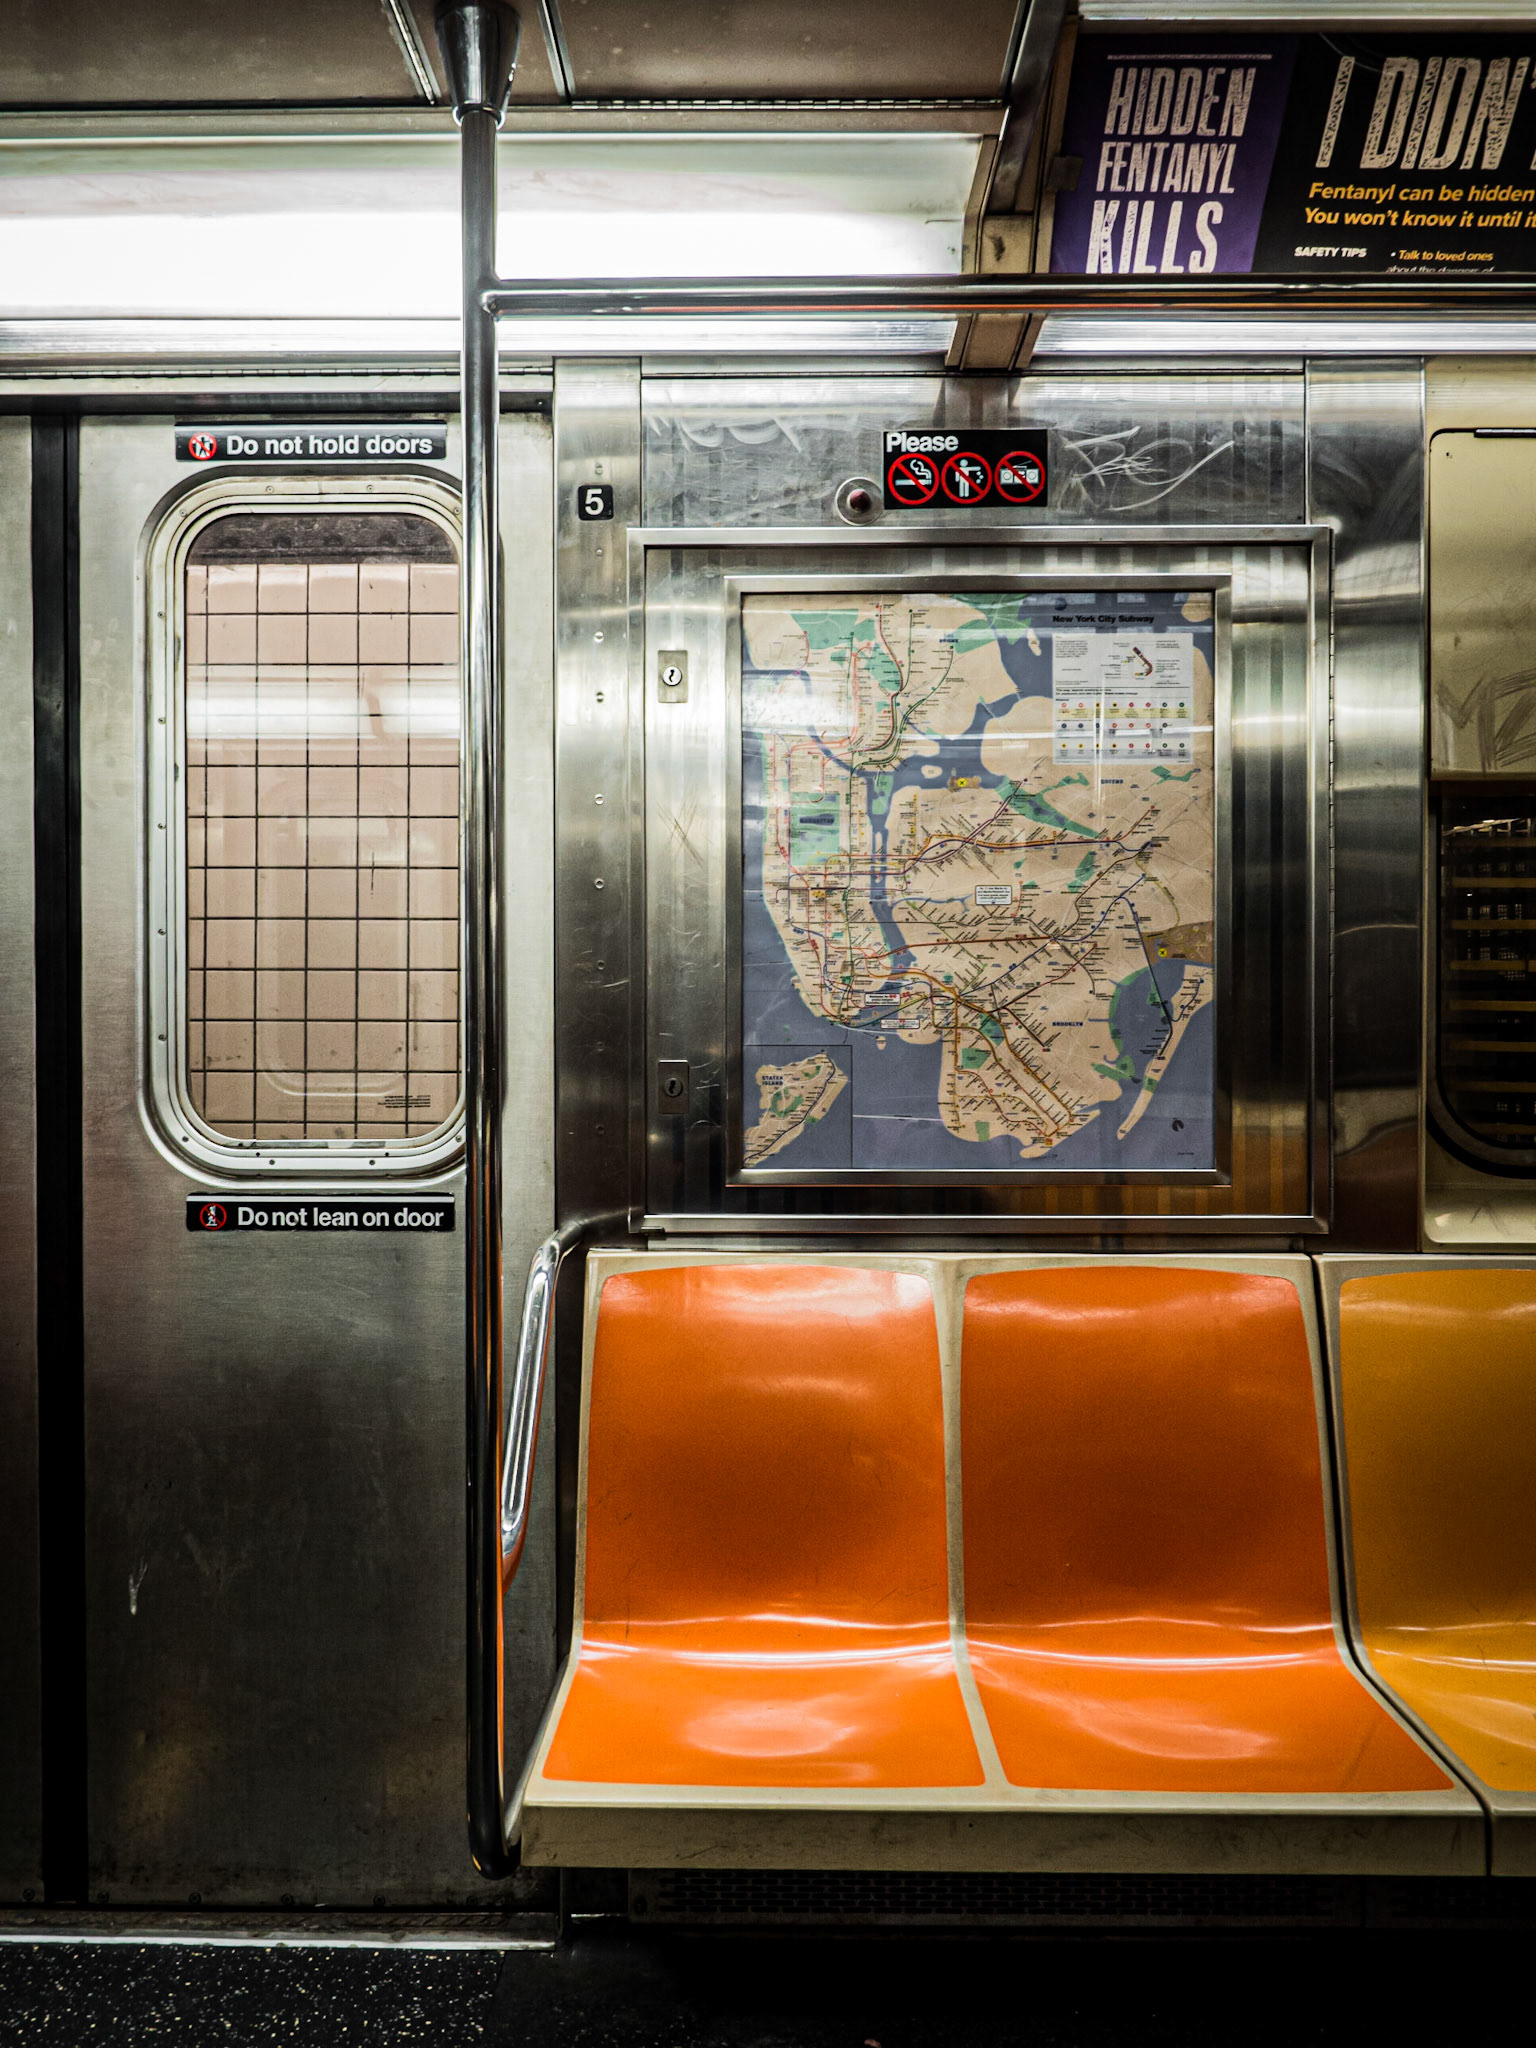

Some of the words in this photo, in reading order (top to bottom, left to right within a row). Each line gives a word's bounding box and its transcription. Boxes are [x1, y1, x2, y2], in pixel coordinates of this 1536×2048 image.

[1104, 67, 1256, 137] HIDDEN
[1315, 56, 1355, 168] I
[1360, 57, 1536, 170] DIDN'
[1096, 142, 1236, 193] FENTANYL
[1308, 182, 1396, 204] Fentanyl
[1399, 188, 1433, 201] can
[1438, 185, 1464, 201] be
[1467, 185, 1535, 202] hidden
[1305, 208, 1339, 224] You
[1344, 210, 1398, 226] won't
[1402, 211, 1457, 227] know
[1459, 211, 1474, 227] it
[1477, 211, 1522, 228] until
[1085, 200, 1223, 273] KILLS
[1294, 246, 1340, 257] SAFETY
[1341, 247, 1367, 258] TIPS
[1399, 250, 1420, 260] Talk
[1422, 251, 1434, 260] to
[1435, 251, 1466, 261] loved
[1467, 252, 1494, 261] ones
[227, 435, 259, 456] Do
[264, 436, 302, 455] not
[309, 435, 360, 455] hold
[365, 435, 433, 455] doors
[886, 432, 959, 453] Please
[584, 488, 604, 516] 5
[1053, 615, 1074, 623] New
[1075, 615, 1097, 623] York
[1098, 615, 1117, 625] City
[1118, 615, 1155, 624] Subway
[237, 1207, 269, 1227] Do
[272, 1208, 308, 1227] not
[313, 1207, 359, 1227] lean
[362, 1211, 390, 1227] on
[394, 1207, 445, 1227] door
